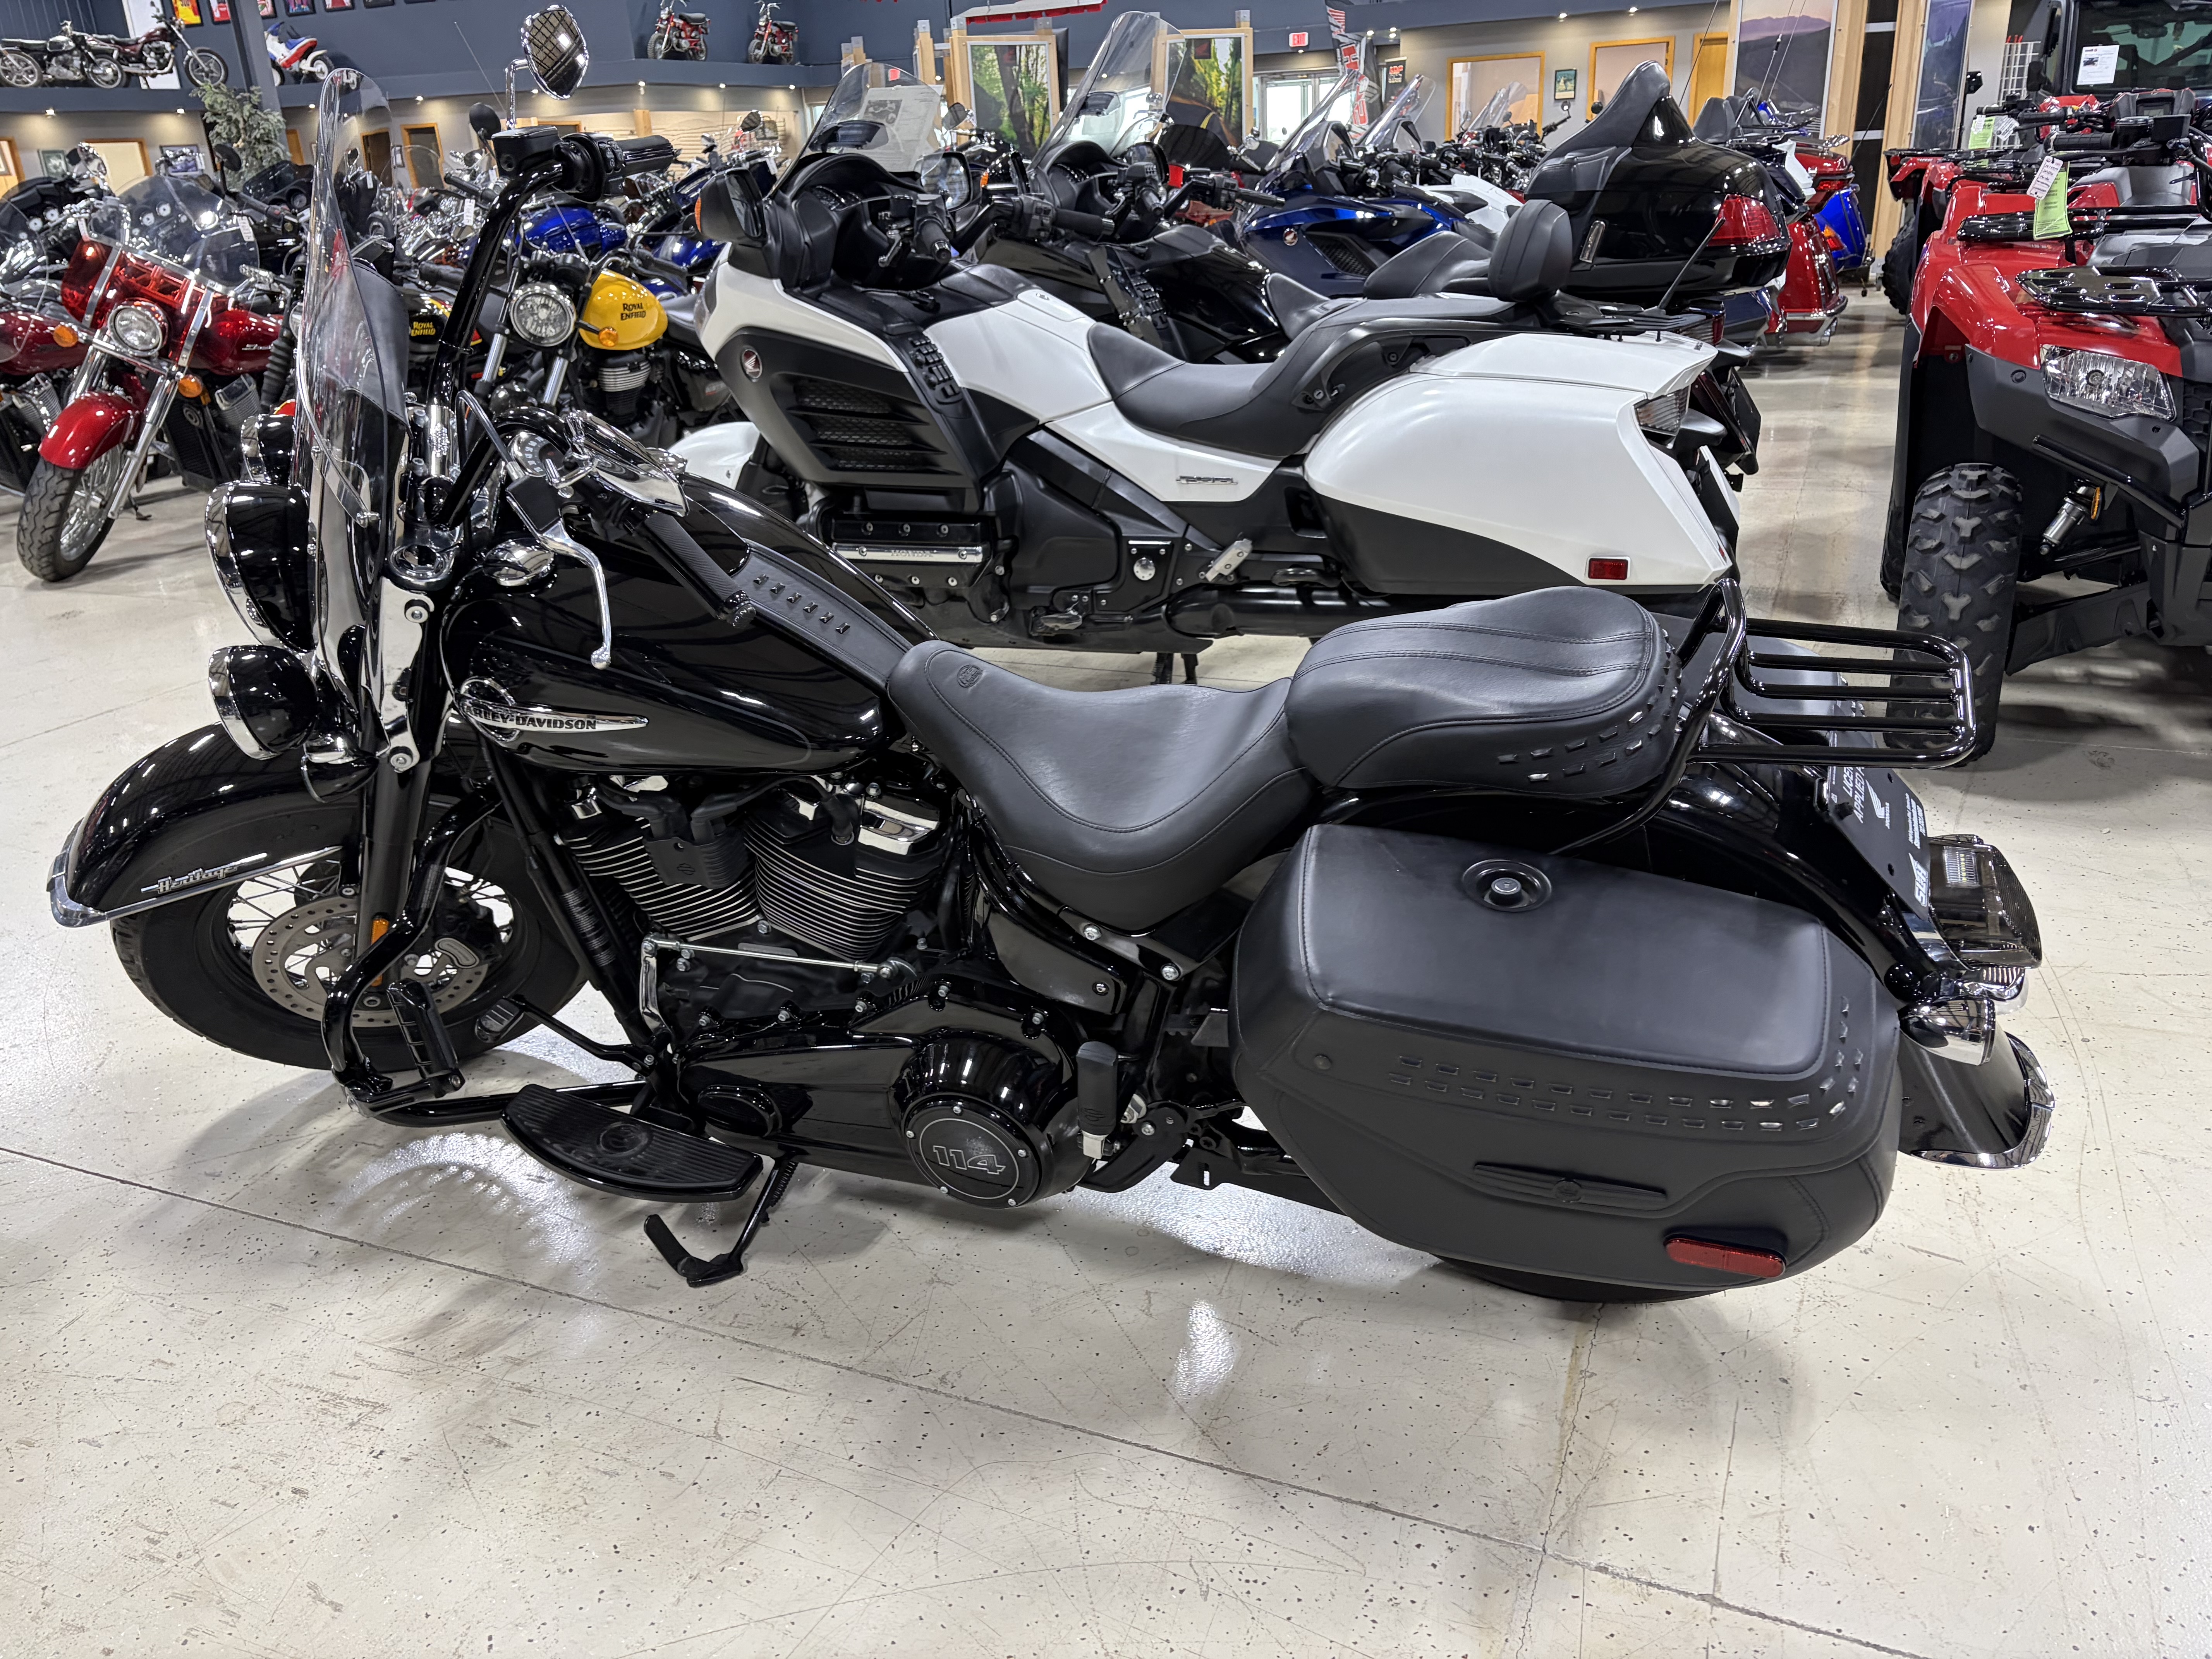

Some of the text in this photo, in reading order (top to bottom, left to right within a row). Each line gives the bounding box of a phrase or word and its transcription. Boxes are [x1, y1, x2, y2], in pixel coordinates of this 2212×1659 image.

[623, 302, 644, 311] ROYAL
[621, 310, 646, 321] ENFIELD
[413, 321, 434, 330] ROYAL
[891, 550, 933, 558] HONDA
[466, 706, 596, 730] ARLEY-DAVIDSON
[1853, 772, 1865, 824] APPLIED
[158, 866, 238, 894] Heritage
[933, 1145, 1006, 1175] 114
